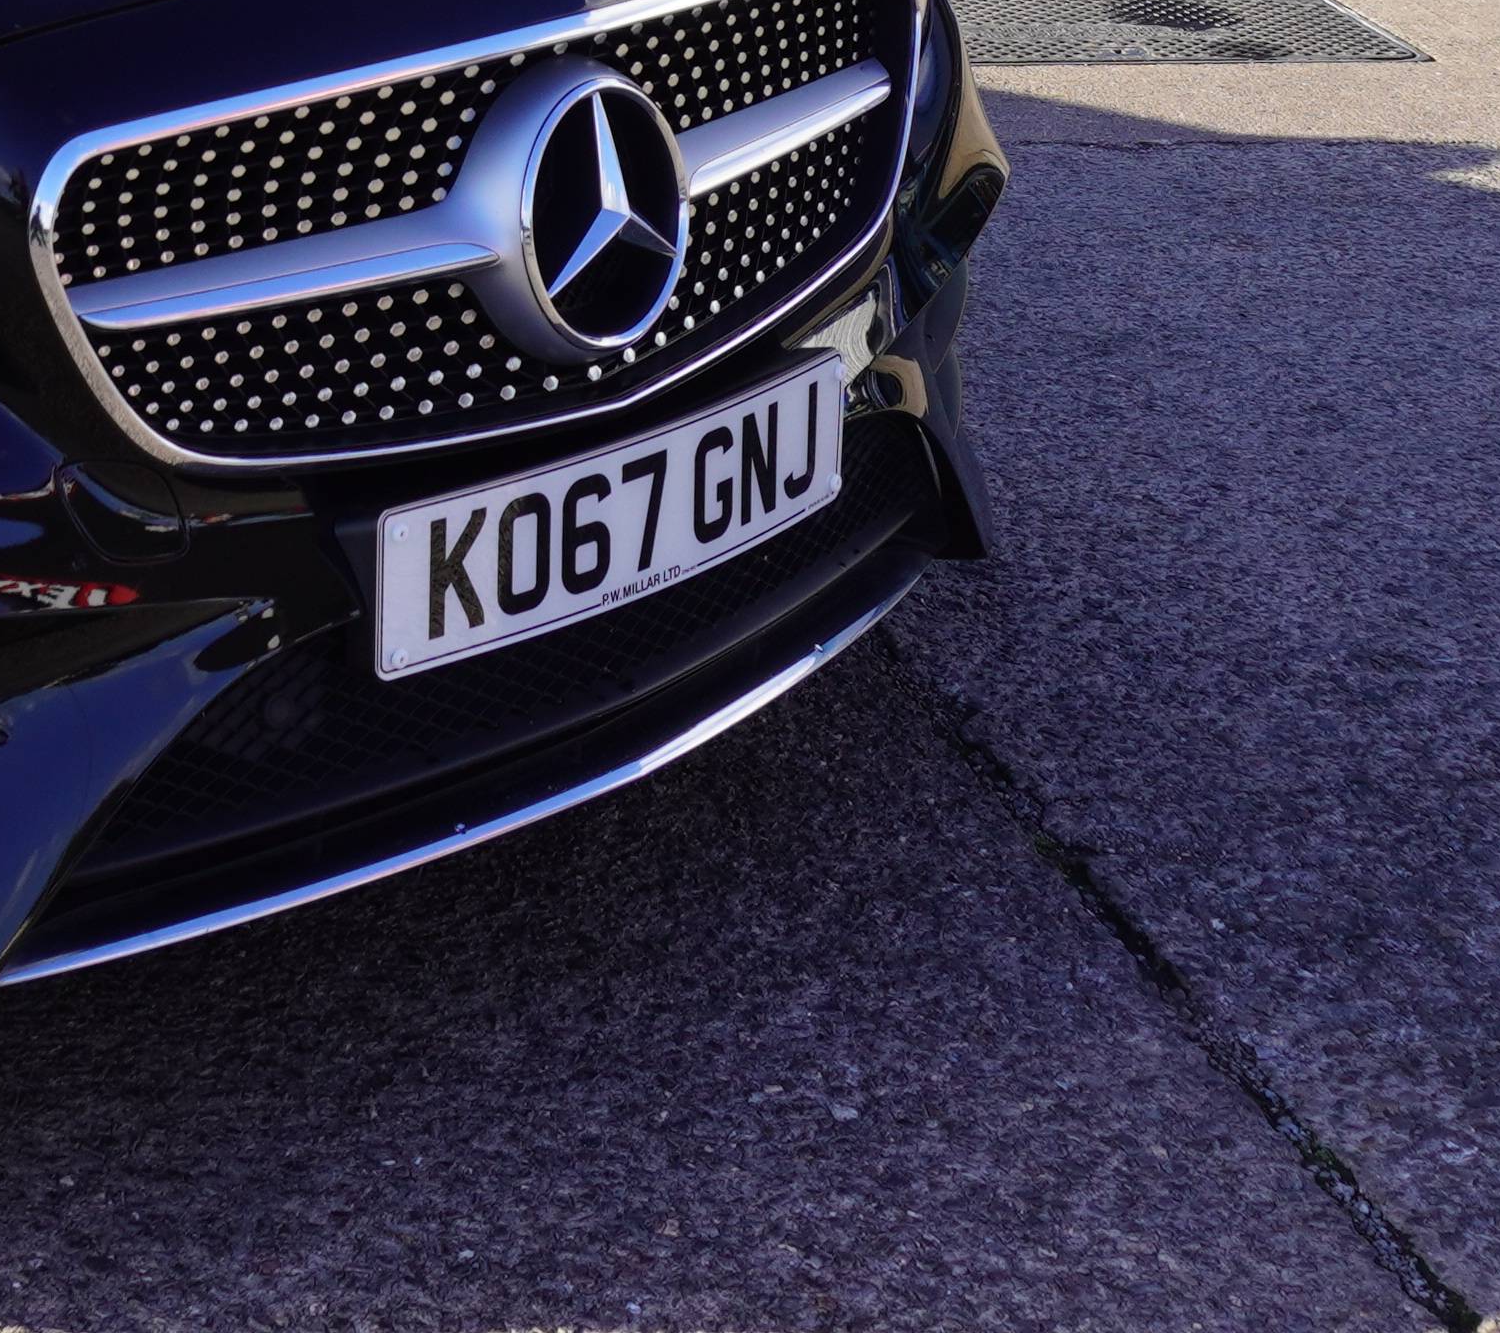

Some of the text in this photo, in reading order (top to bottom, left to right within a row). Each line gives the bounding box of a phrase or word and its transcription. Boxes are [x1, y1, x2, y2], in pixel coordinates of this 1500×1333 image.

[427, 380, 820, 641] KO67 GNJ
[662, 564, 682, 583] LTD
